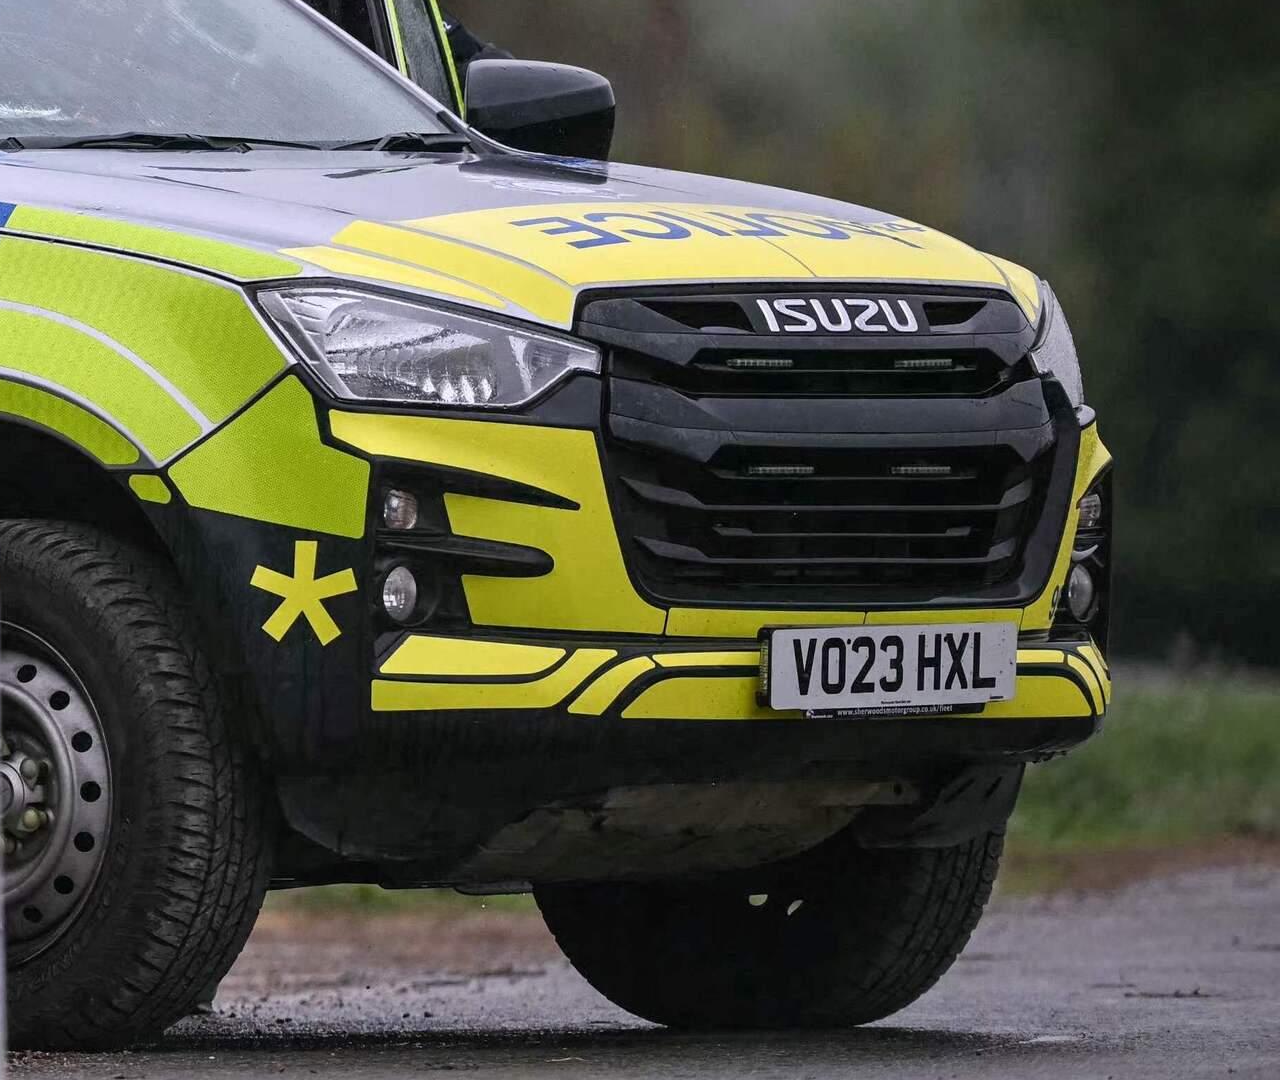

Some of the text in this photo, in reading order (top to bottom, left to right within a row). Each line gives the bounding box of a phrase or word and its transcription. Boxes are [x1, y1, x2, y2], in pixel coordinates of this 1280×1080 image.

[756, 299, 920, 333] ISUZU
[792, 632, 996, 696] VO23 HXL
